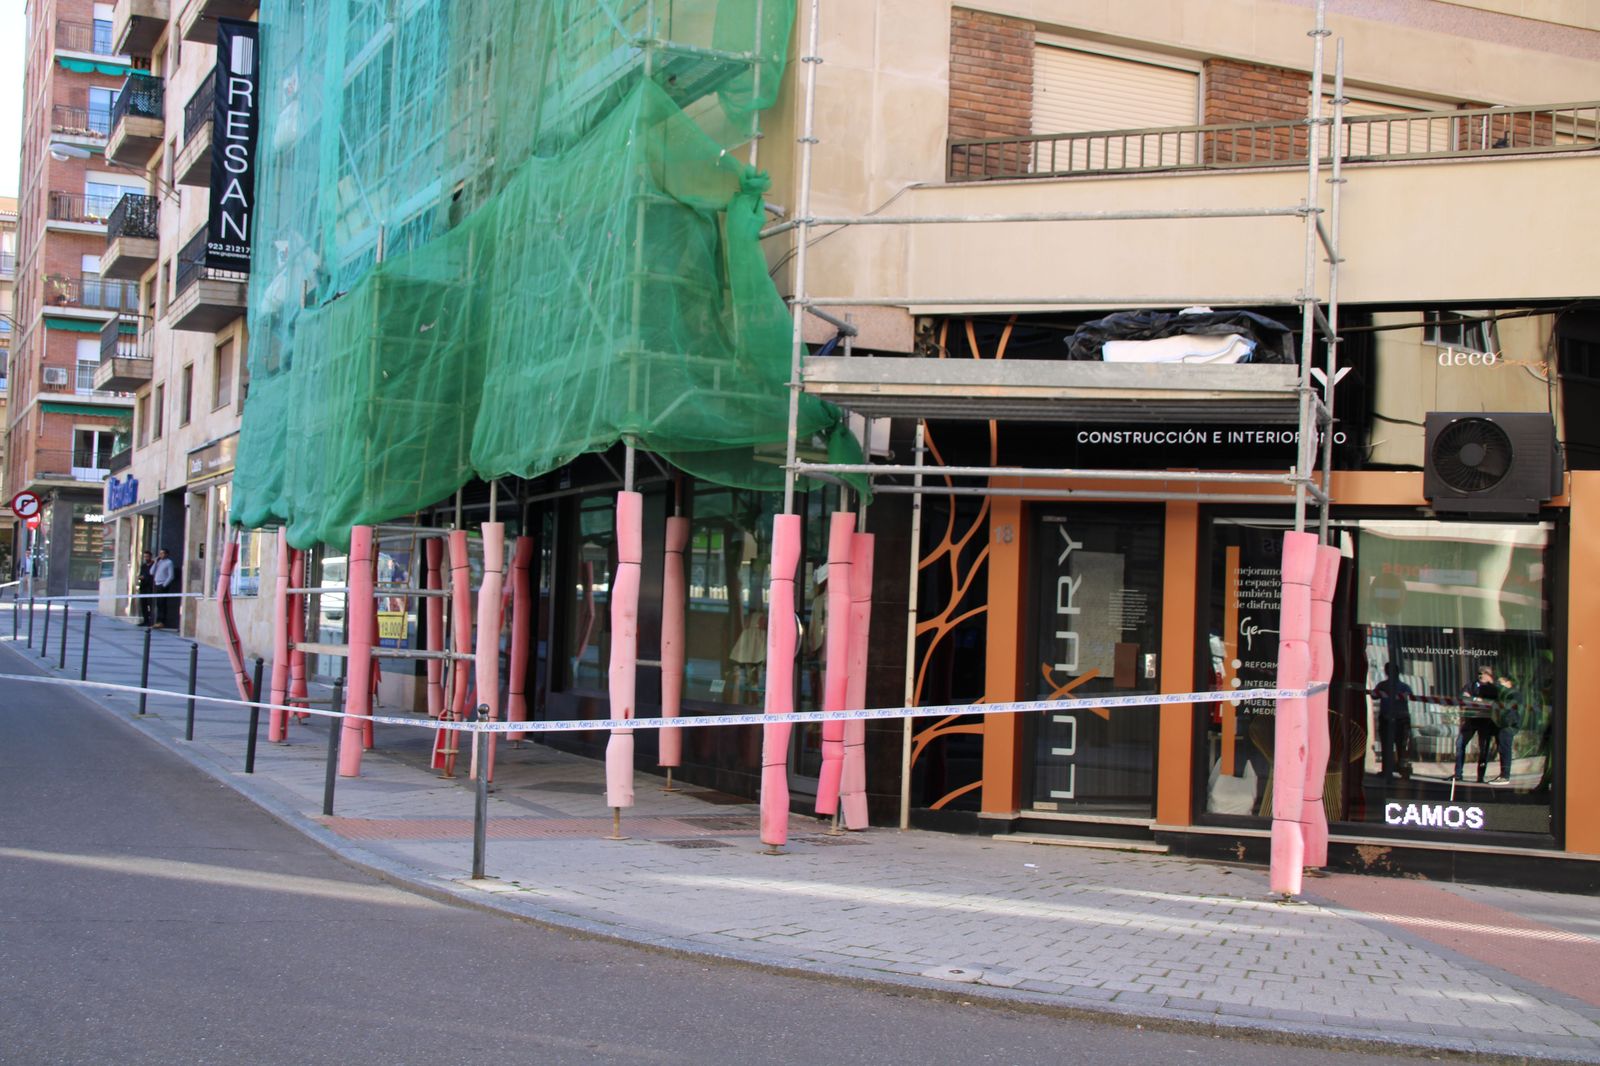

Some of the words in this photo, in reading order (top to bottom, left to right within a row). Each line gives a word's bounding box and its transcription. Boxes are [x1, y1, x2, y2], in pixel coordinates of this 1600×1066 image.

[220, 77, 254, 241] RESAN
[208, 242, 223, 251] 923
[1439, 347, 1496, 366] deco
[1077, 429, 1207, 444] CONSTRUCCIÓN
[1213, 431, 1222, 443] E
[1233, 589, 1272, 598] también
[1233, 600, 1245, 609] de
[1401, 646, 1498, 658] www.luxurydesign.es
[1385, 803, 1484, 829] CAMOS
